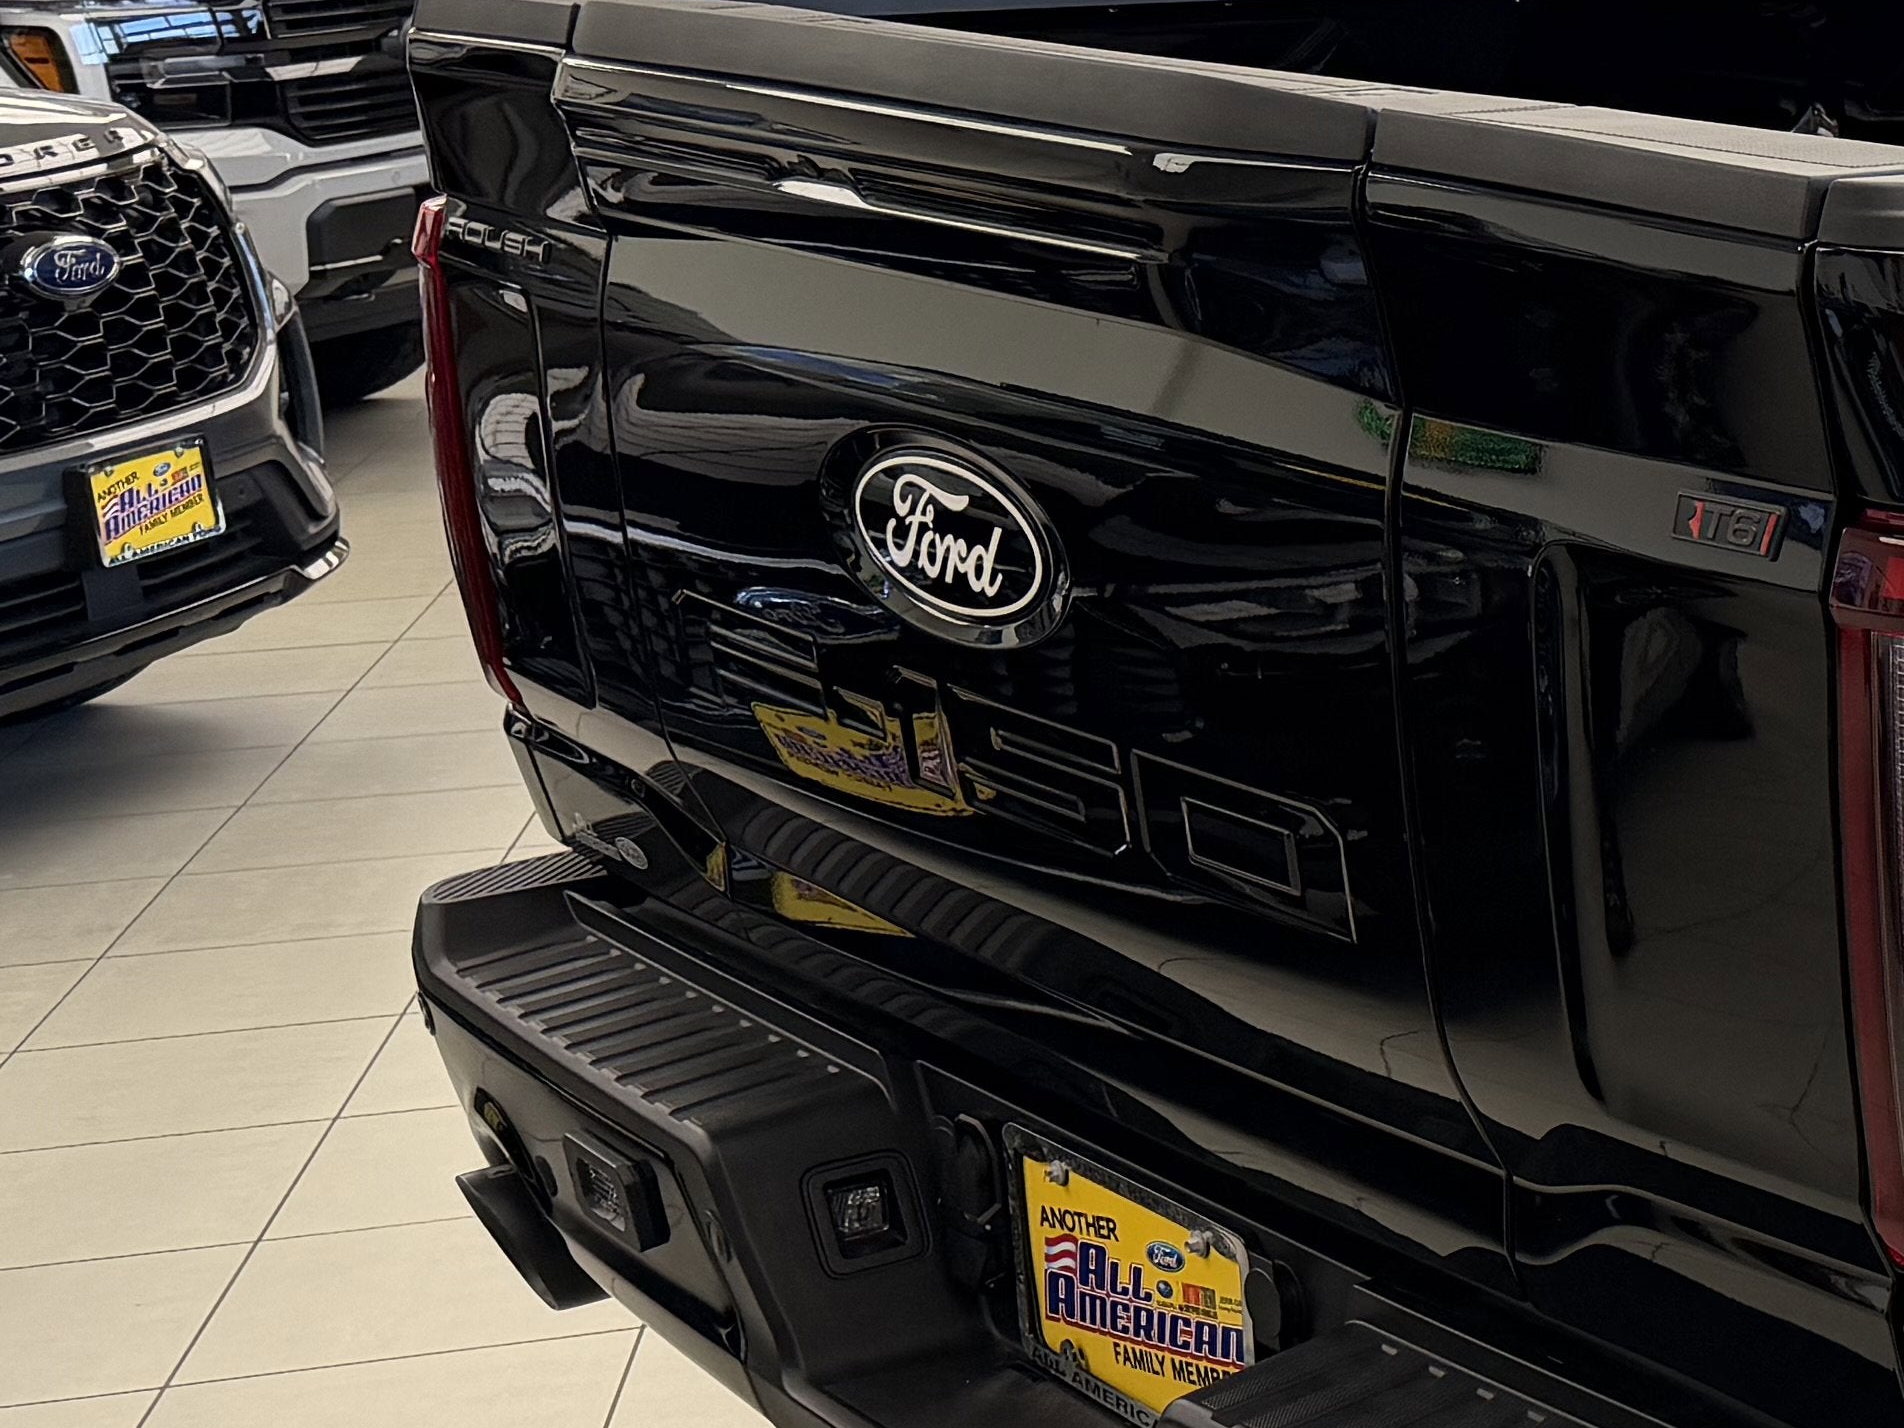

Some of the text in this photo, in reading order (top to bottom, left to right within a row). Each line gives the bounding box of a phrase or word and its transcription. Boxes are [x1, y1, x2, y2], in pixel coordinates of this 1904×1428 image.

[446, 215, 552, 264] ROUSH
[53, 249, 105, 285] Ford
[97, 471, 139, 503] ANOTHER
[104, 474, 202, 541] AMERICAN
[119, 483, 158, 513] ALL
[139, 493, 204, 536] FAMILY MEMBER
[886, 474, 1002, 597] Ford
[1704, 508, 1759, 546] T6
[1039, 1205, 1120, 1242] ANOTHER
[1077, 1240, 1153, 1304] ALL
[1151, 1247, 1179, 1268] Ford
[1046, 1268, 1246, 1368] AMERICAN
[1113, 1342, 1238, 1388] FAMILY MEMB
